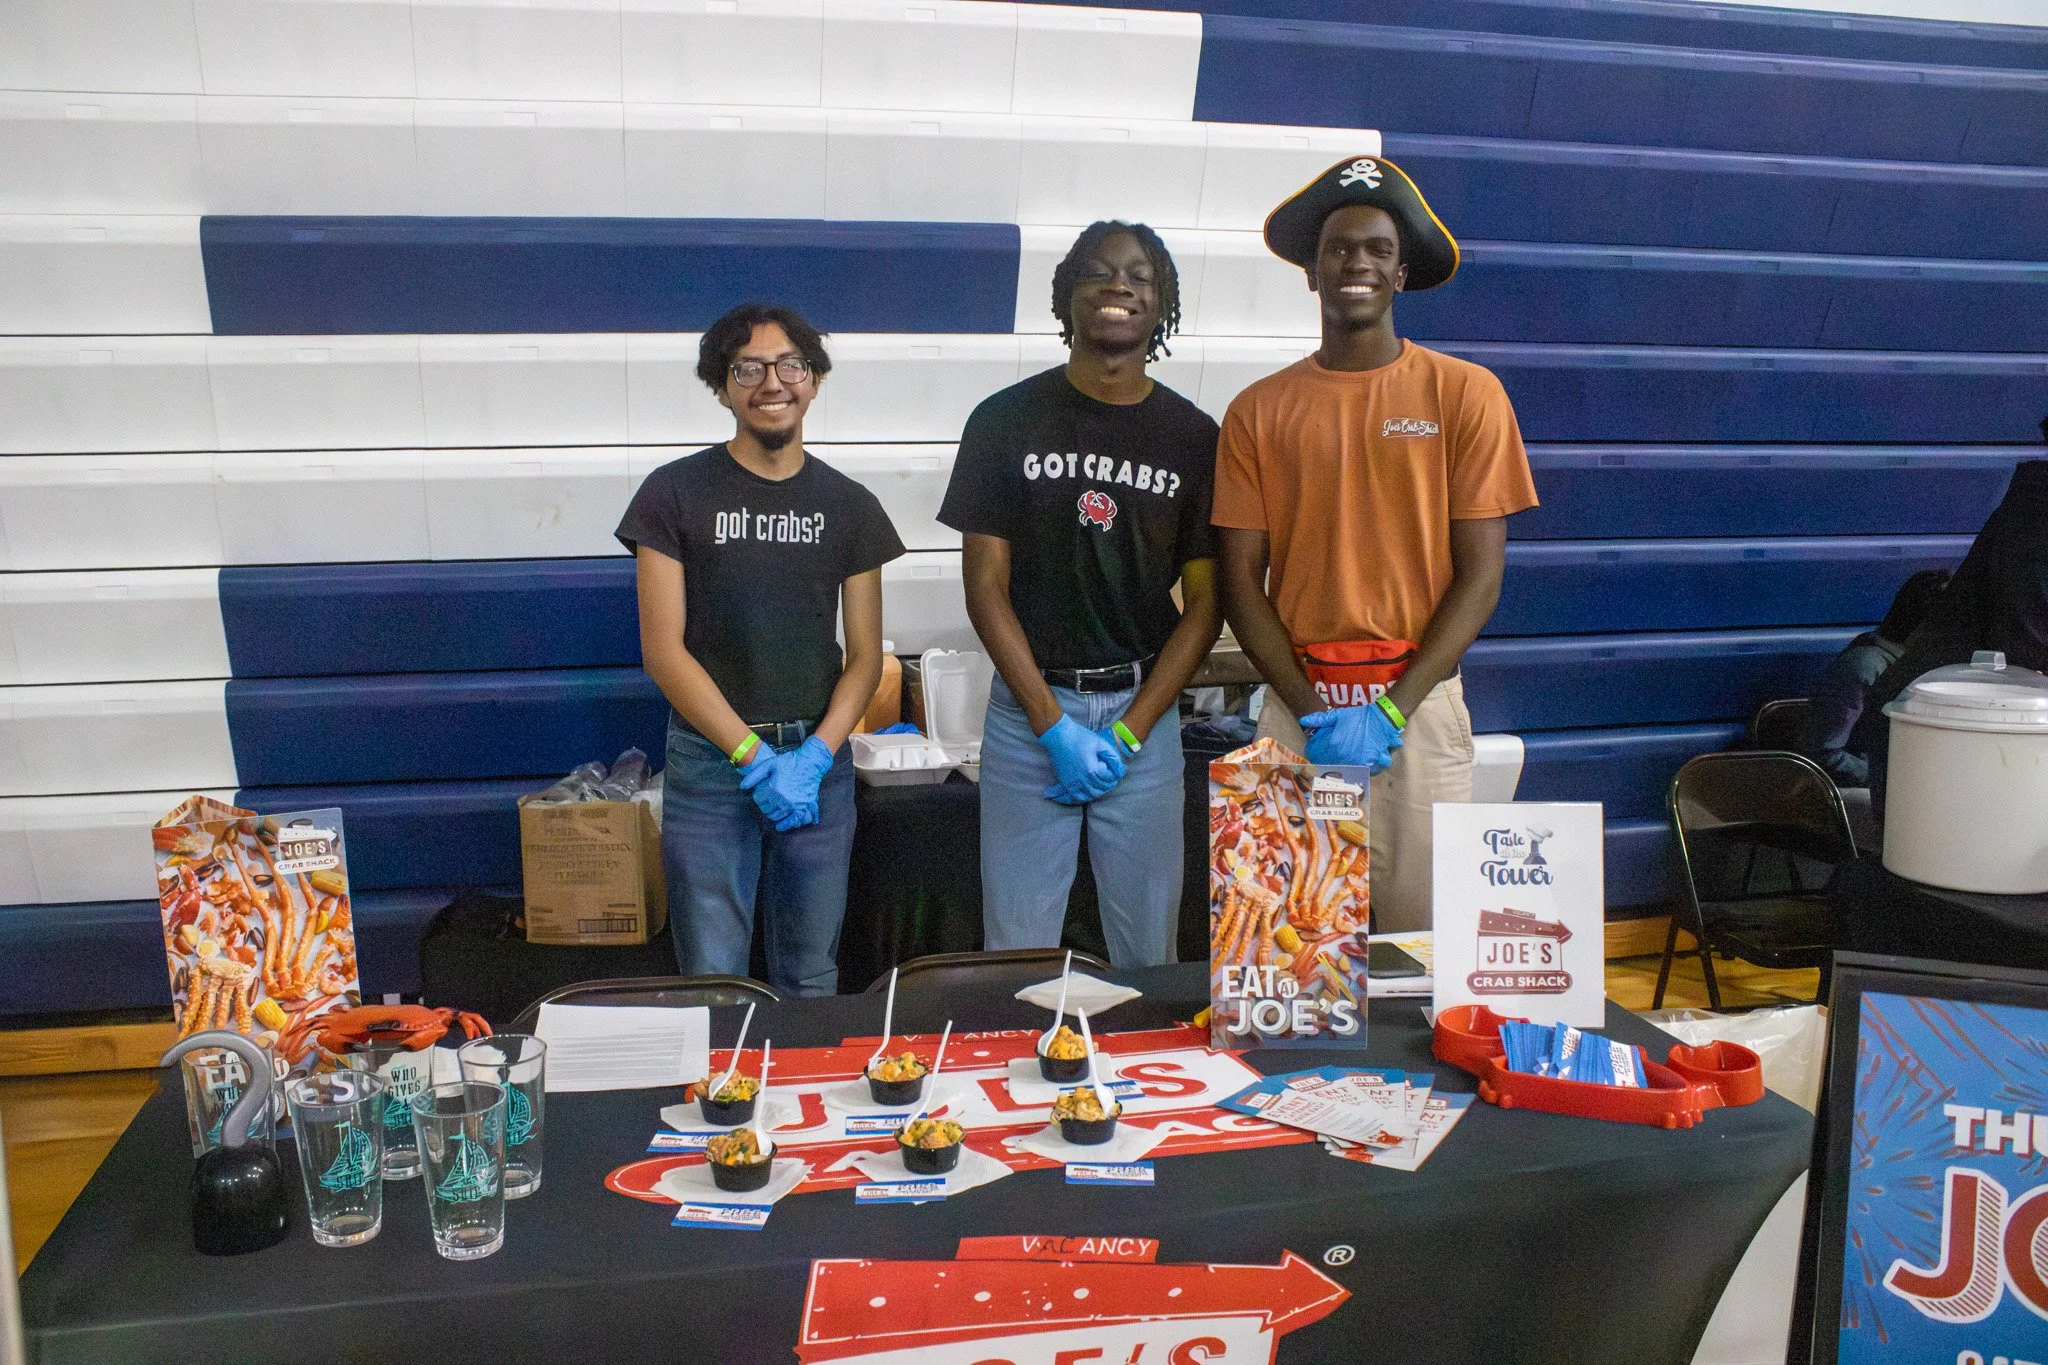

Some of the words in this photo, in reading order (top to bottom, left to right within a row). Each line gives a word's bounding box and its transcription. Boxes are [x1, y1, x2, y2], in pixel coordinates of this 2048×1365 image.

[1023, 453, 1078, 481] GOT
[1083, 454, 1181, 498] CRABS?
[715, 507, 751, 544] got
[756, 510, 825, 543] crabs?
[1314, 681, 1397, 707] GUAR
[1316, 793, 1353, 806] JOE'S
[285, 840, 327, 857] JOE'S
[1483, 828, 1525, 855] Taste
[278, 861, 304, 871] CRAB
[305, 857, 336, 868] SHACK
[1480, 860, 1553, 886] Tower
[1486, 942, 1552, 964] JOE'S
[1221, 965, 1280, 998] EAT
[1473, 976, 1514, 988] CRAB
[1517, 975, 1568, 987] SHACK
[1226, 998, 1359, 1034] JOE'S
[390, 1067, 417, 1083] WHO
[387, 1080, 421, 1098] GIVES
